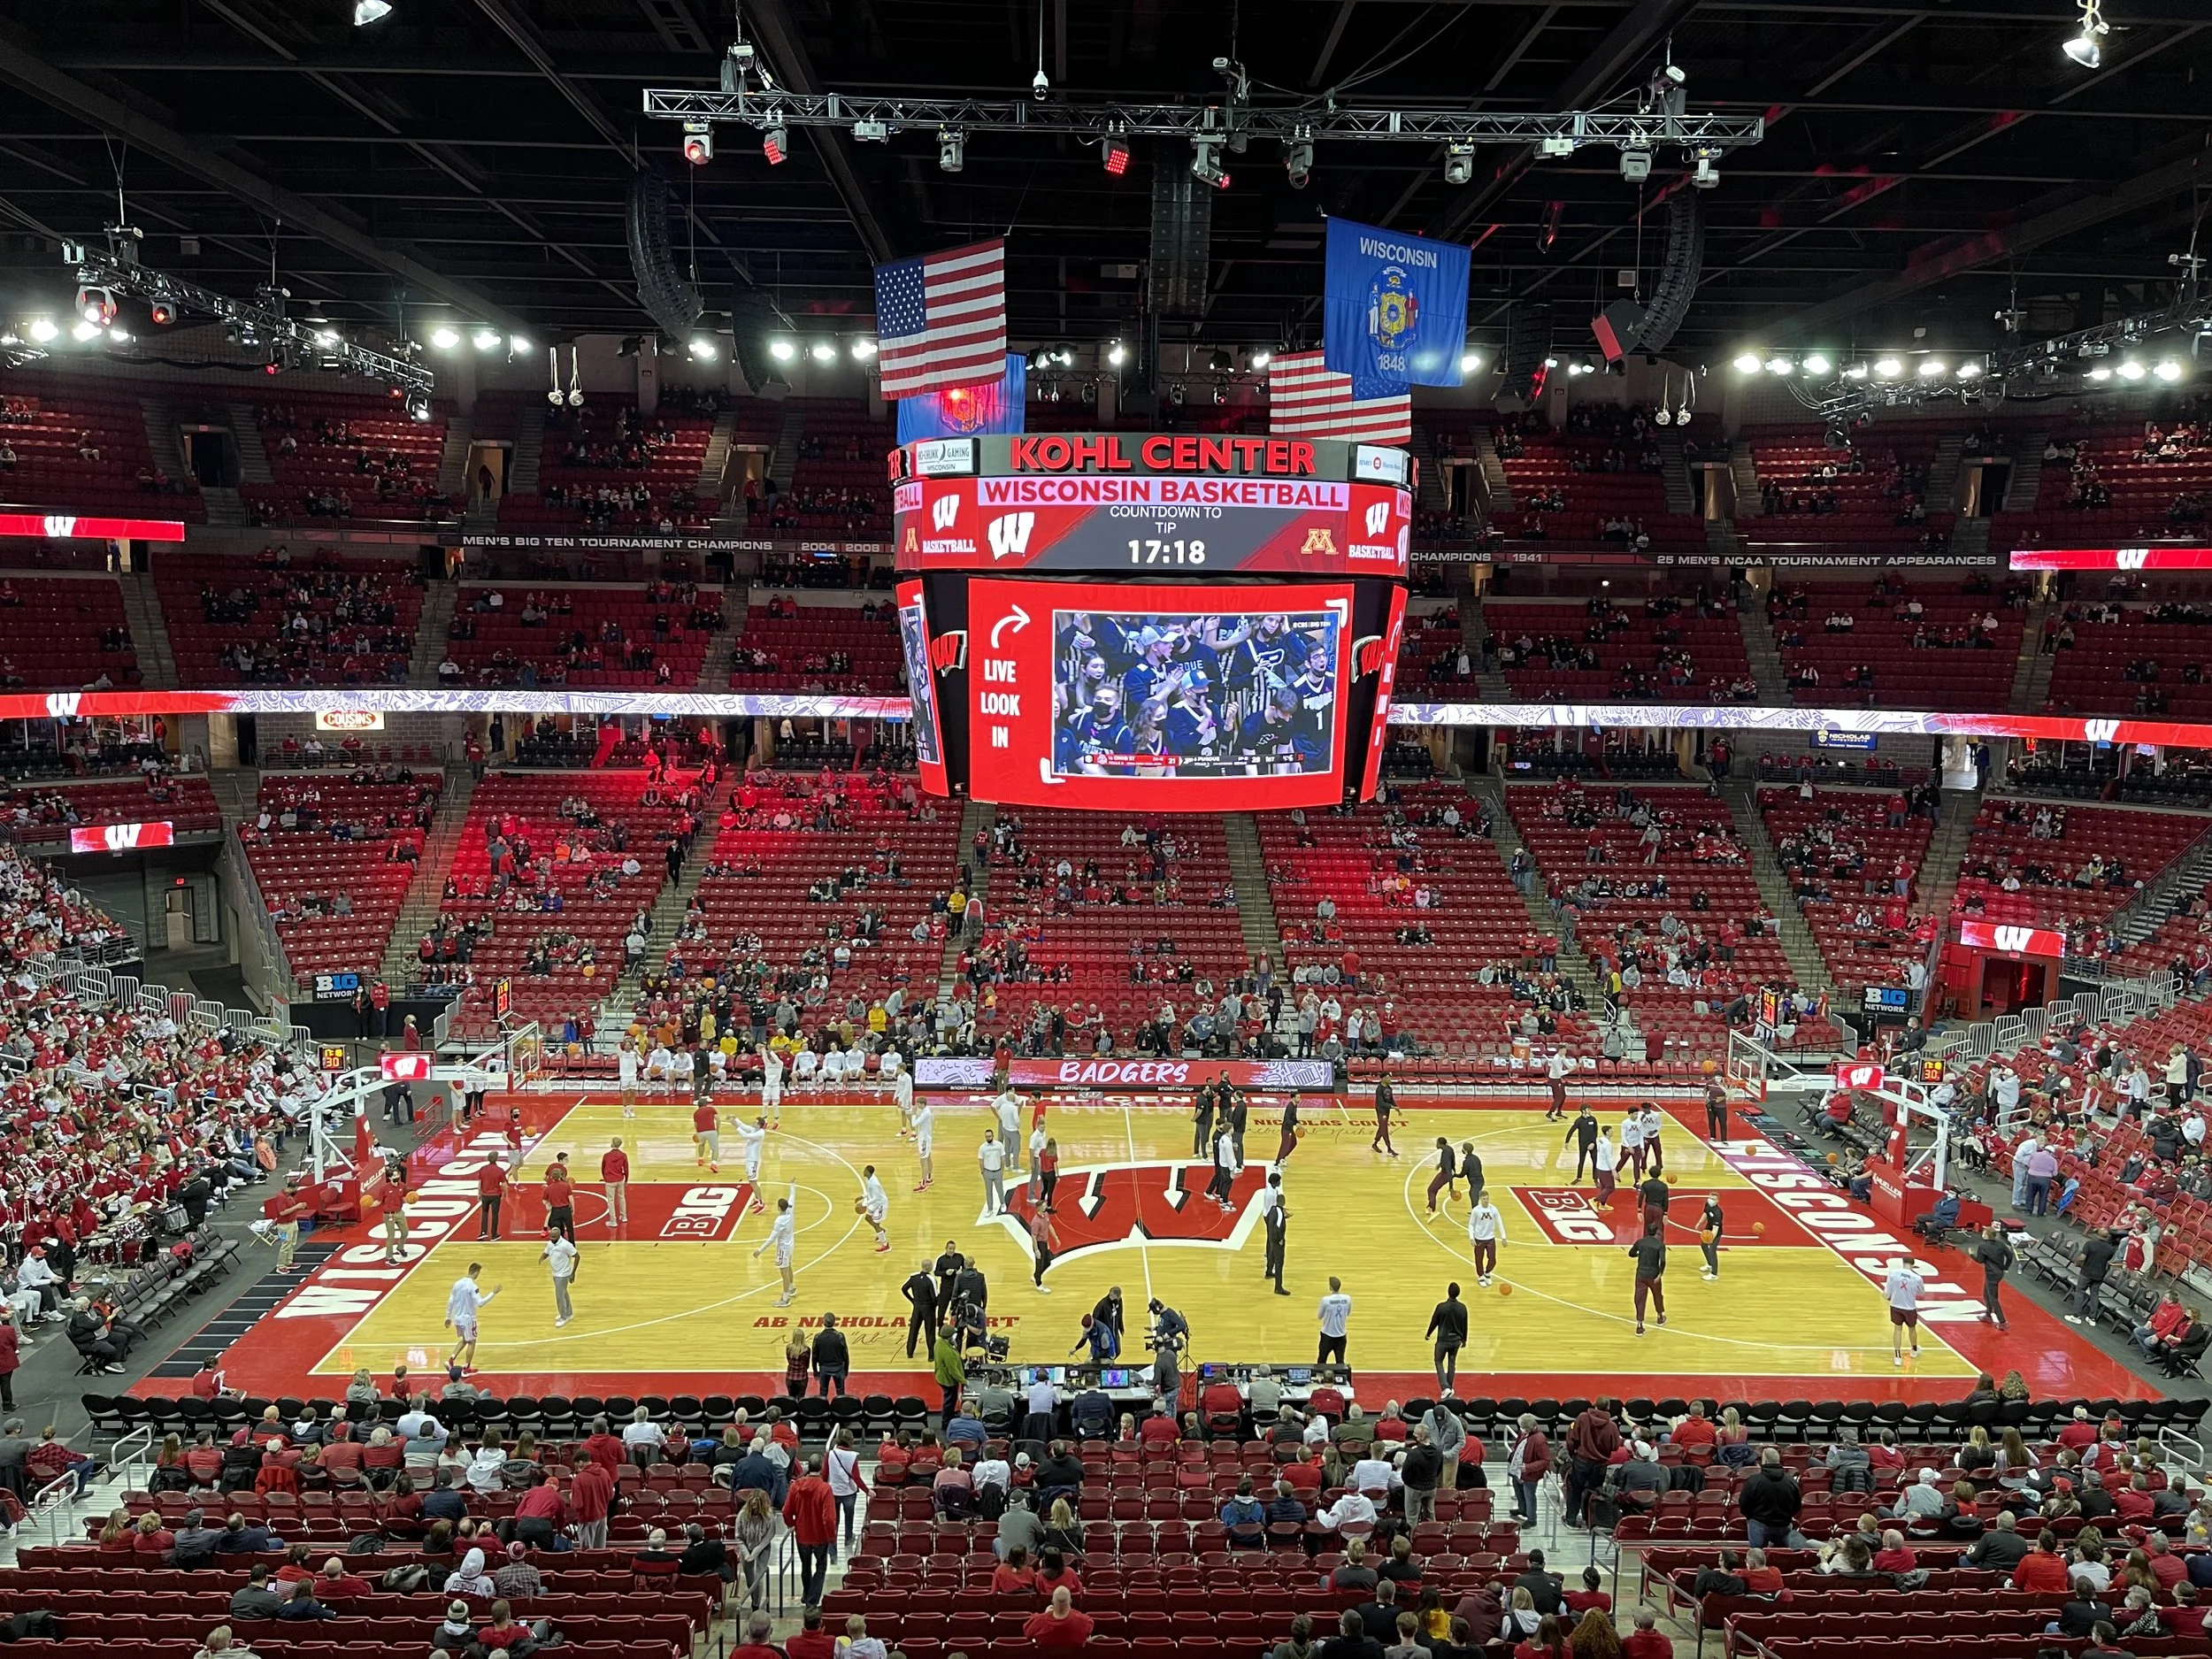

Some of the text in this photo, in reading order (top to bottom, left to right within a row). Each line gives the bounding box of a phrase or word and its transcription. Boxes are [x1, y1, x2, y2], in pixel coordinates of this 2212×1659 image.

[1360, 236, 1437, 269] WISCONSIN
[1378, 353, 1406, 372] 1848
[947, 447, 970, 457] GAMING
[1010, 435, 1317, 473] KOHL CENTER
[887, 449, 902, 481] TER
[985, 480, 1344, 508] WISCONSIN BASKETBALL
[933, 494, 960, 533] W
[1110, 505, 1222, 518] COUNTDOWN TO
[1365, 502, 1390, 538] W
[44, 516, 76, 537] W
[987, 511, 1035, 562] W
[1155, 522, 1177, 534] TIP
[463, 536, 880, 552] MEN'S BIG TEN TOURNAMENT CHAMPIONS 2004 2008
[923, 539, 976, 553] BASKETBALL
[1128, 540, 1206, 565] 17:18
[1301, 528, 1338, 555] M
[1348, 544, 1395, 560] BASKETBALL
[1409, 552, 1542, 563] CHAMPIONS 1941
[1657, 556, 1997, 566] 25 MEN'S NCAA TOURNAMENT APPEARANCES
[2116, 549, 2148, 570] W
[984, 658, 1017, 683] LIVE
[46, 693, 81, 716] W
[980, 691, 1020, 716] LOOK
[326, 712, 373, 726] COUSINS
[2084, 718, 2120, 741] W
[992, 726, 1009, 748] IN
[104, 823, 142, 850] W
[1993, 924, 2033, 952] W
[326, 1057, 340, 1067] 30
[1058, 1062, 1189, 1084] BADGERS
[1103, 1095, 1280, 1104] CENR
[1875, 1175, 1903, 1199] MUELLER
[753, 1317, 788, 1327] AB
[797, 1317, 911, 1327] NIHOLA
